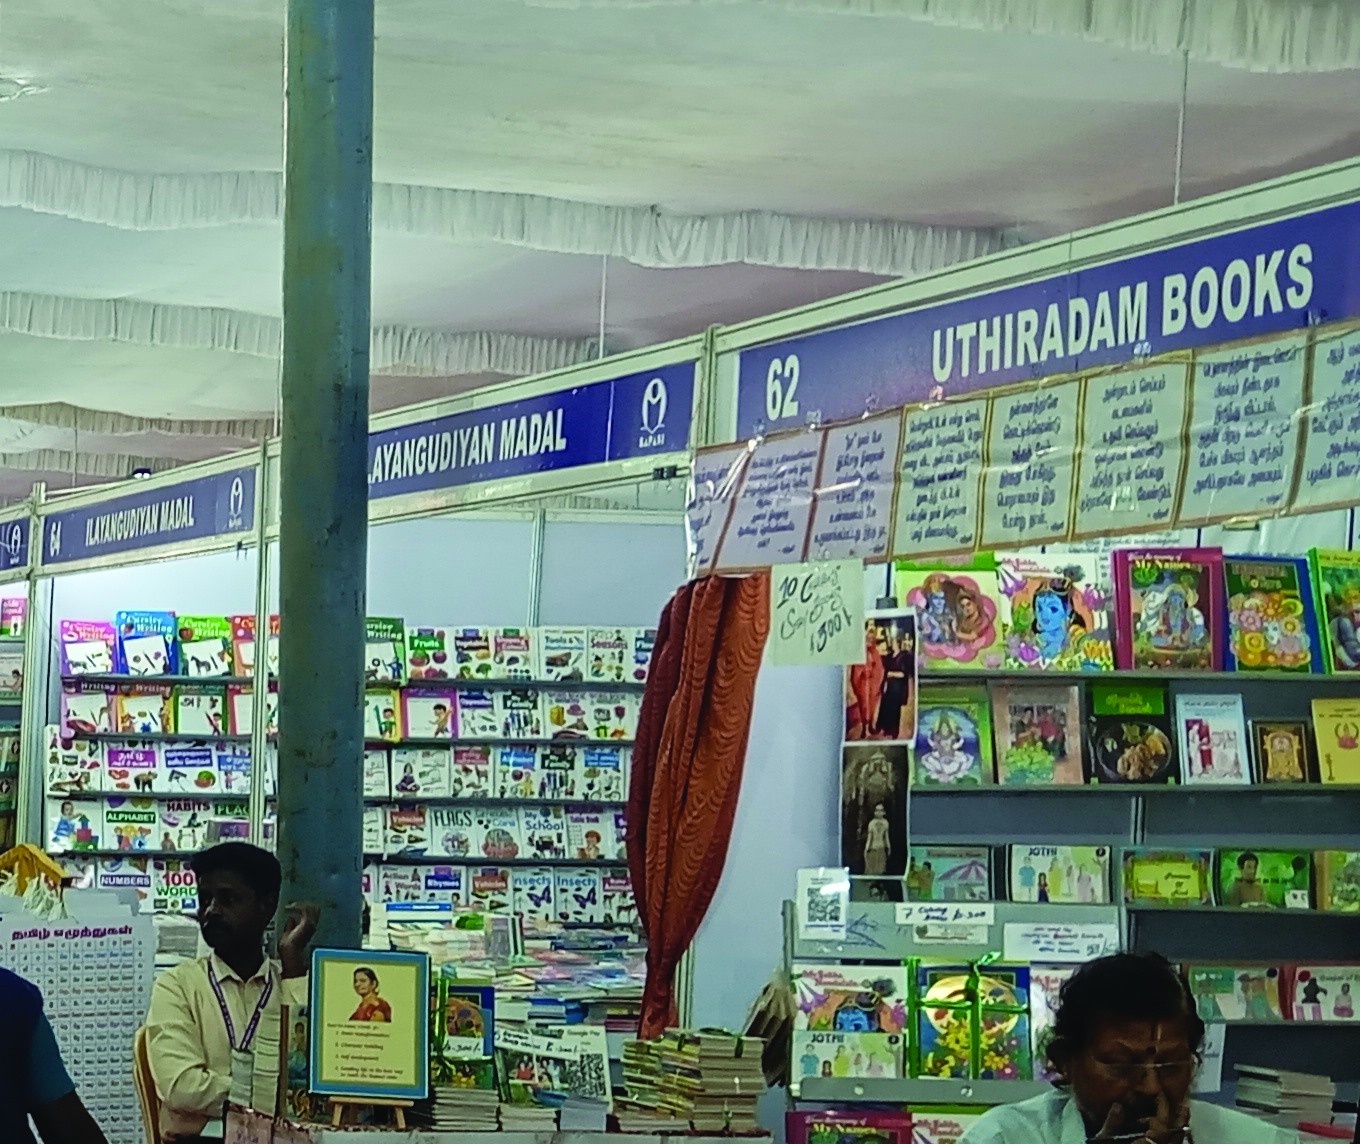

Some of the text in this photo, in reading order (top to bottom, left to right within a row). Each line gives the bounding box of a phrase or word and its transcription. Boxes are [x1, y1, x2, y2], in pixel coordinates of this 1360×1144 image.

[932, 243, 1314, 382] UTHIRADAM BOOKS
[766, 355, 800, 421] 62
[499, 408, 567, 461] MADAL
[85, 503, 160, 548] ILAYANGUDIYAN
[160, 495, 195, 531] MADAL
[136, 623, 173, 633] Writing
[413, 639, 441, 649] Fruits
[166, 800, 211, 813] HABITS
[106, 811, 156, 823] ALPHABET
[433, 811, 474, 828] FLAGS
[525, 819, 565, 832] School
[100, 875, 151, 887] NUMBERS
[557, 876, 598, 888] Insects
